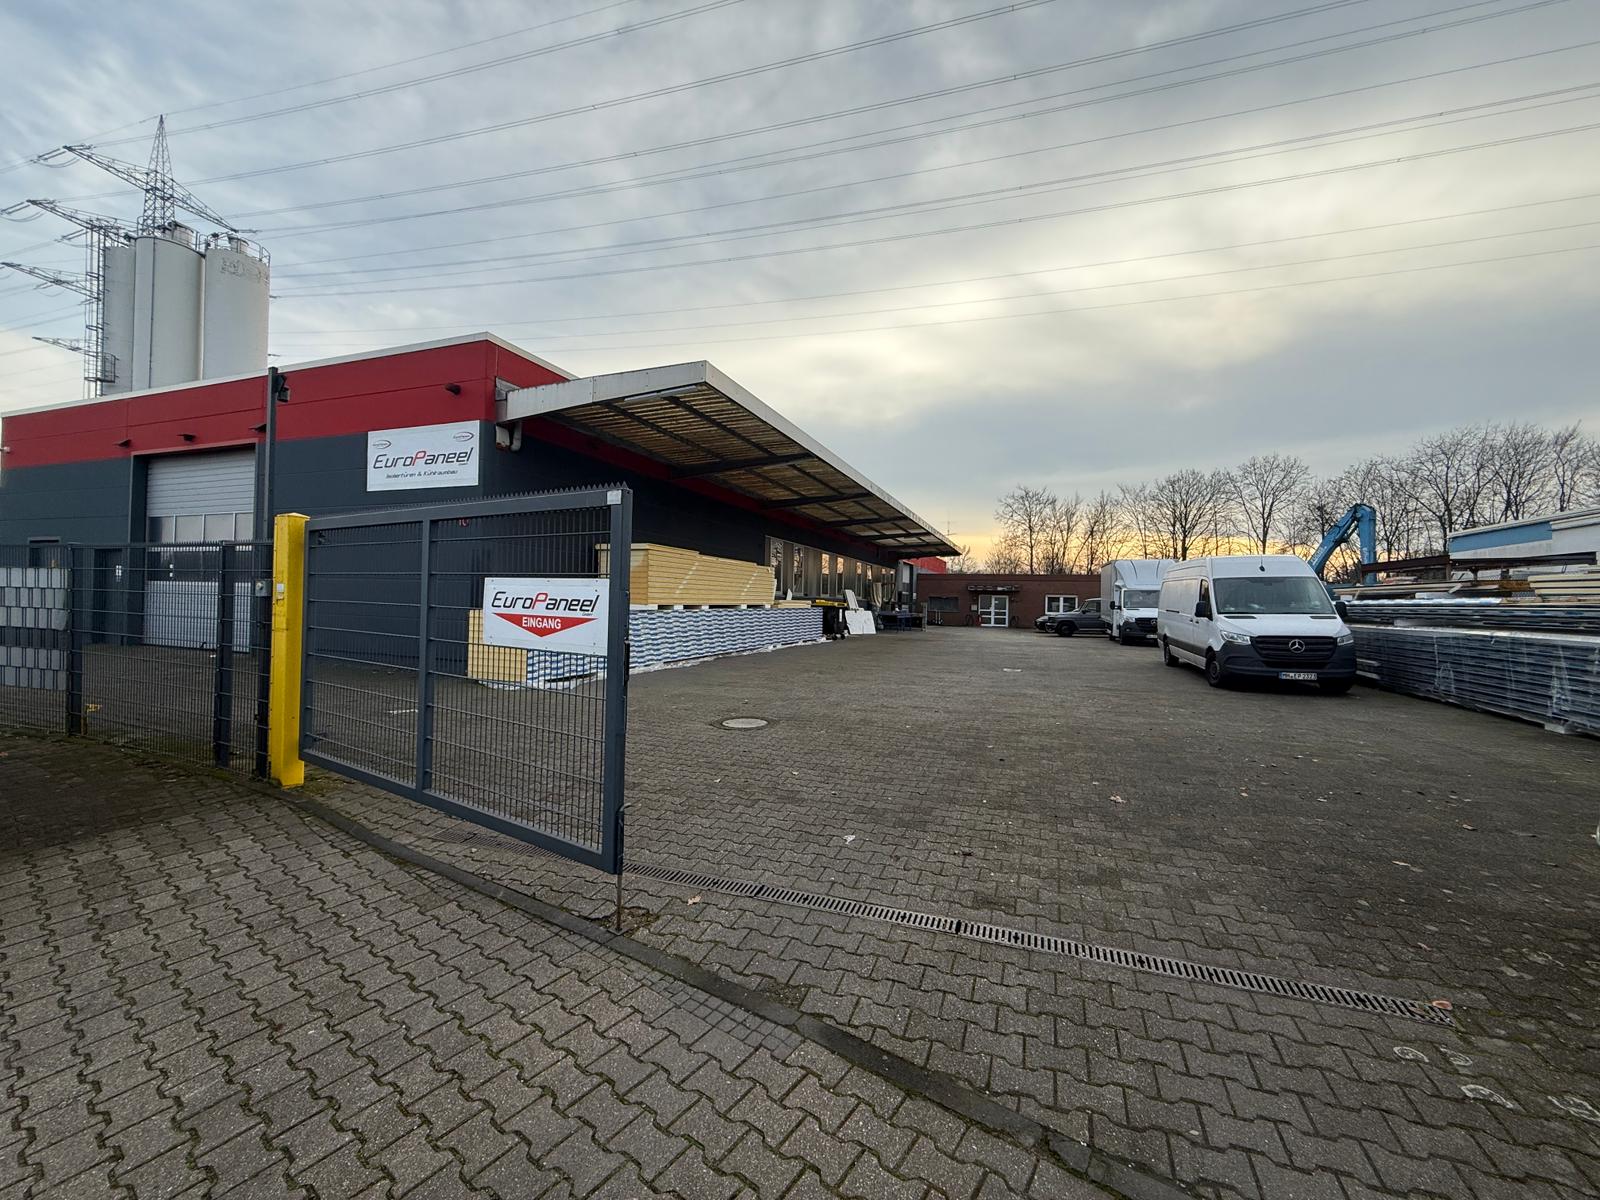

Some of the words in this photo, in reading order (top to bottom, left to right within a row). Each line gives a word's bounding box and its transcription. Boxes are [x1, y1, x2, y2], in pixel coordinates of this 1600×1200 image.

[373, 447, 474, 469] EuroPaneel
[491, 591, 600, 612] EuroPaneel
[522, 616, 562, 629] EINGANG
